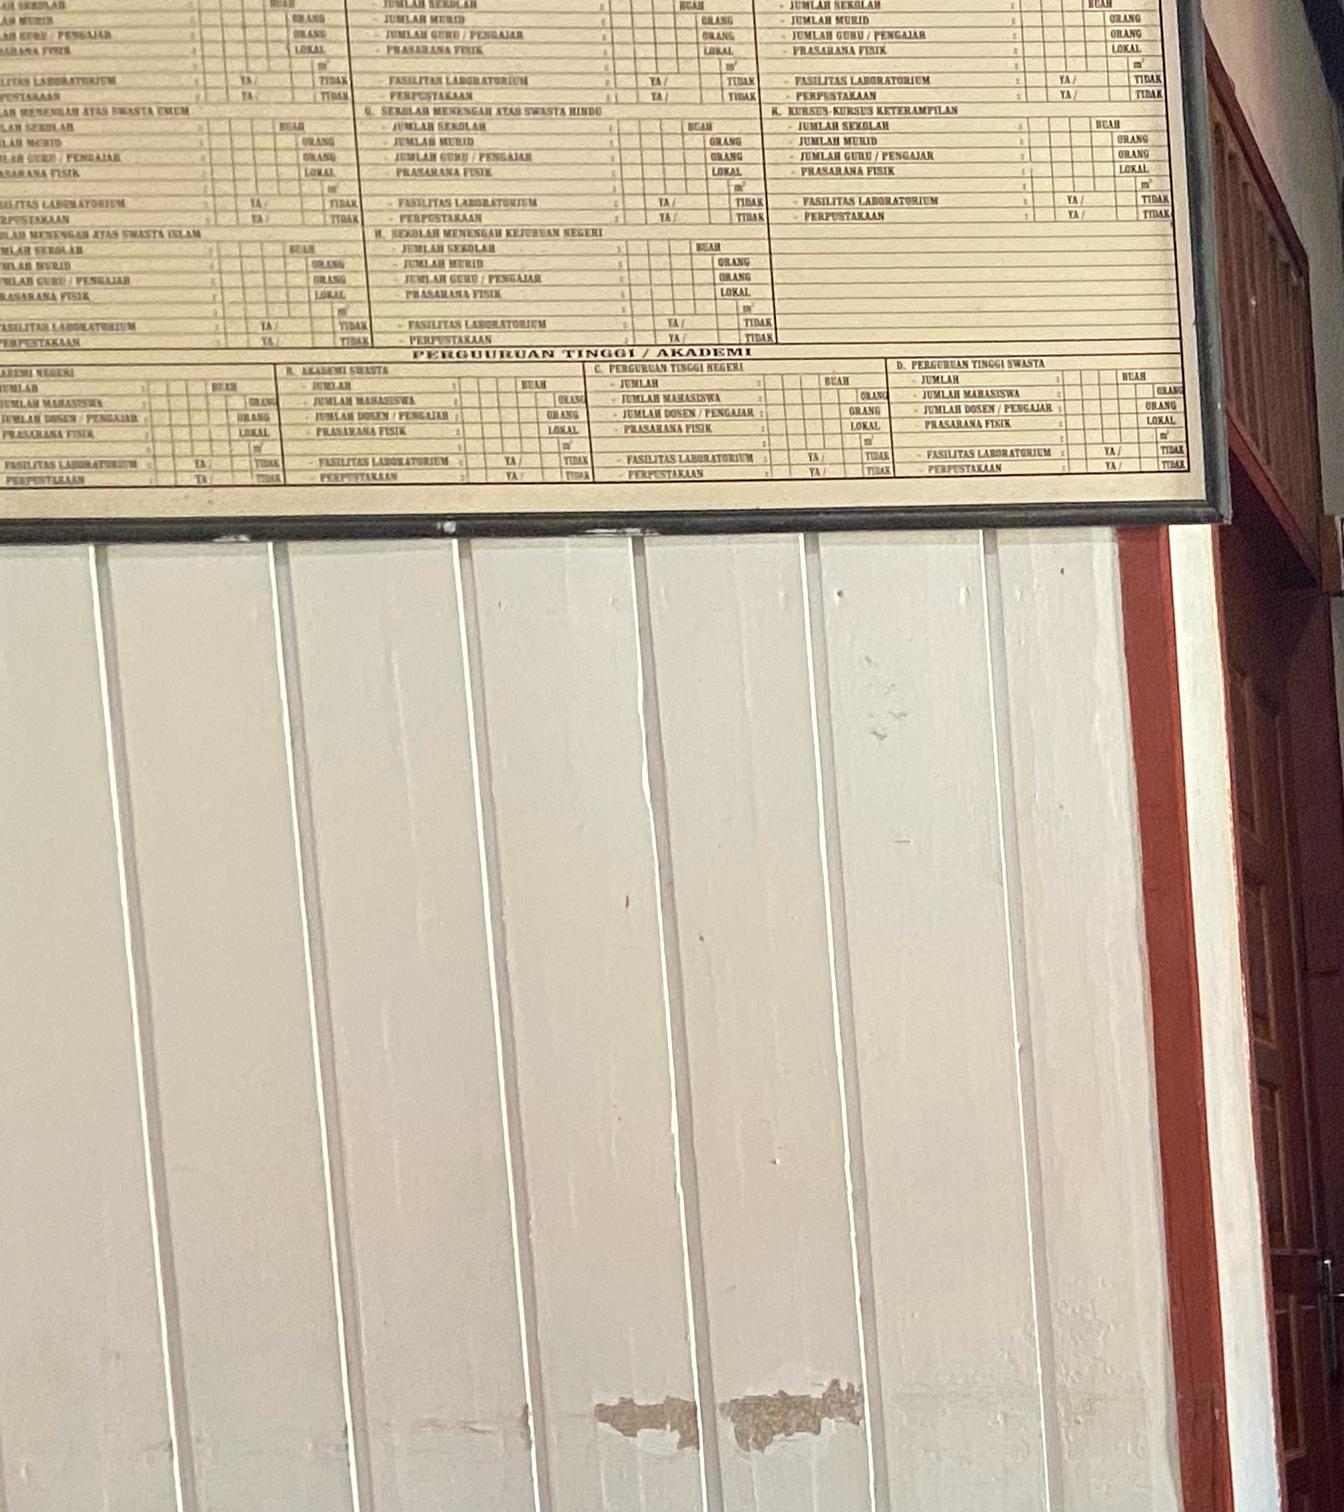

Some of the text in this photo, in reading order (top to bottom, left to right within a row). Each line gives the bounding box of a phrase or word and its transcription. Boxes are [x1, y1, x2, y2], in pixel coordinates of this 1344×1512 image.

[561, 348, 635, 359] TINGGI
[656, 347, 751, 357] AKADEMI
[669, 362, 704, 373] TINGGI
[970, 359, 1005, 369] TINGGI
